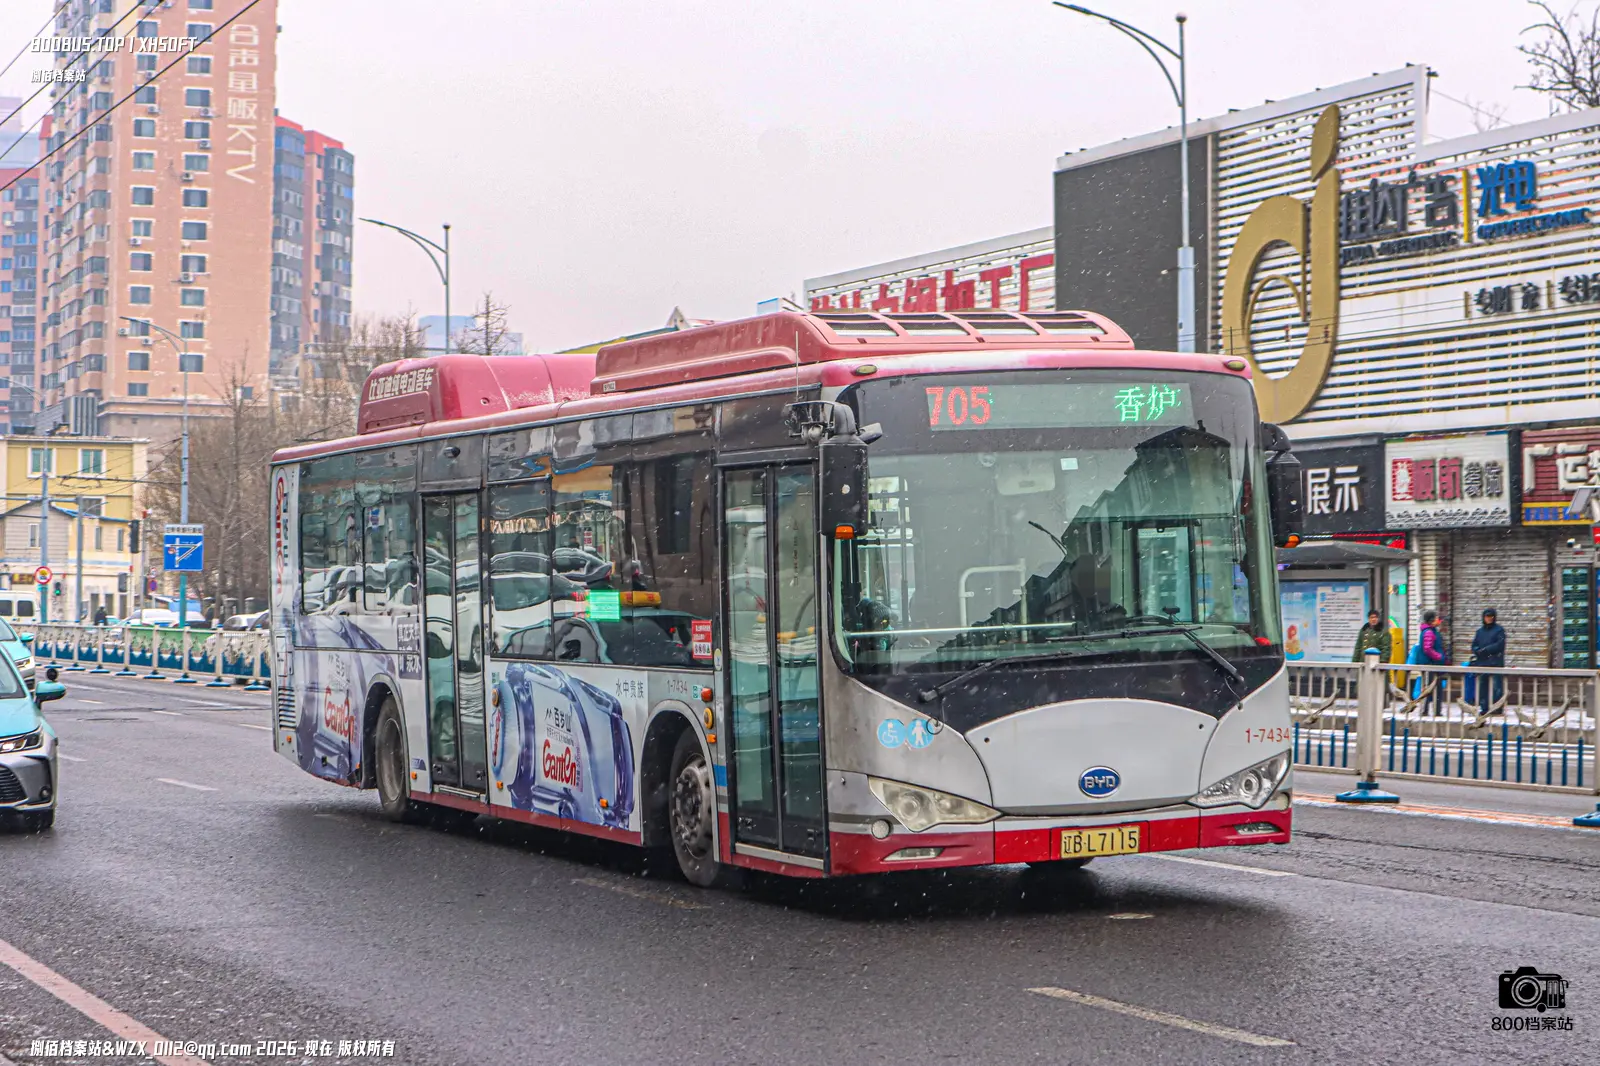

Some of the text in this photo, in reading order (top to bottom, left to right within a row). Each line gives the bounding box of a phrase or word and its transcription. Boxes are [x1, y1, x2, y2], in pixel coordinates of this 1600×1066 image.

[1476, 160, 1536, 217] 光电
[369, 367, 434, 400] 比亚迪纯电动客车
[925, 387, 991, 426] 705
[1307, 466, 1360, 515] 展示
[616, 679, 644, 698] 水中贵族
[667, 680, 688, 694] 1-7434
[1245, 727, 1290, 744] 1-7434
[543, 739, 577, 786] Ganten
[1085, 775, 1116, 789] BYD
